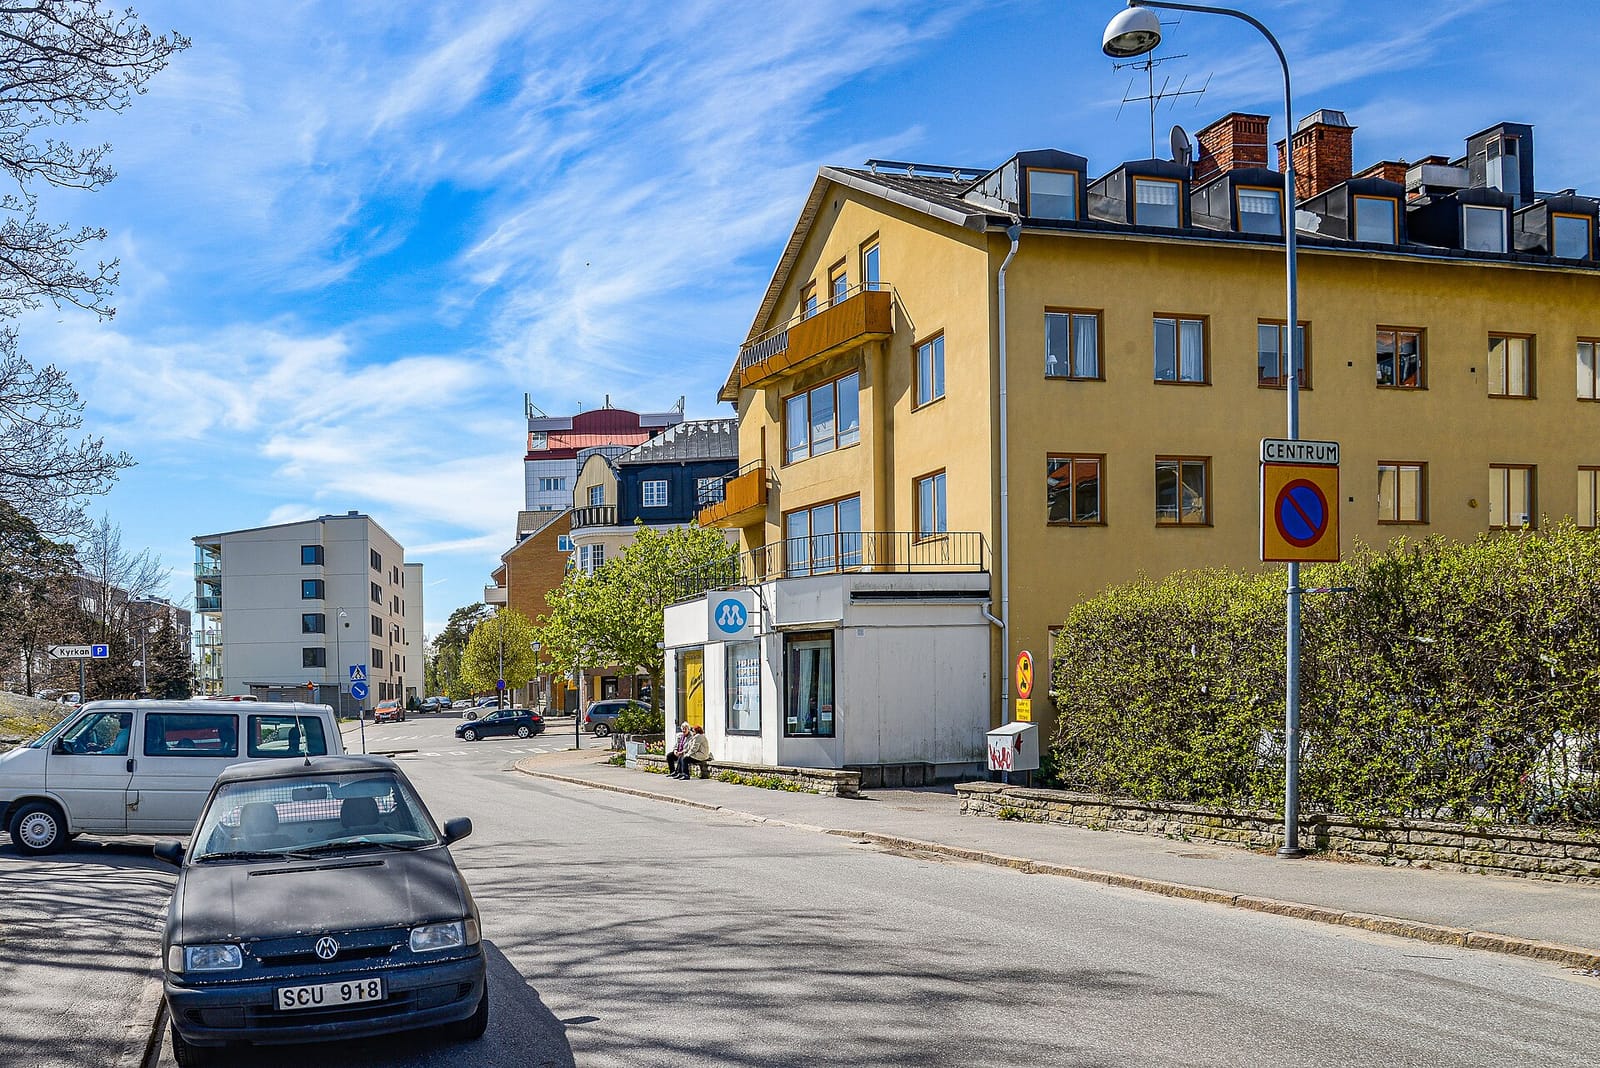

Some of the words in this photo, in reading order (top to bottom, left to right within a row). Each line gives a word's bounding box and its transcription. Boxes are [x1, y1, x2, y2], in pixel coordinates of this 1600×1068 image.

[1266, 443, 1337, 461] CENTRUM
[59, 648, 90, 656] Kyrkan
[283, 986, 324, 1007] SCU
[340, 981, 379, 1001] 918
